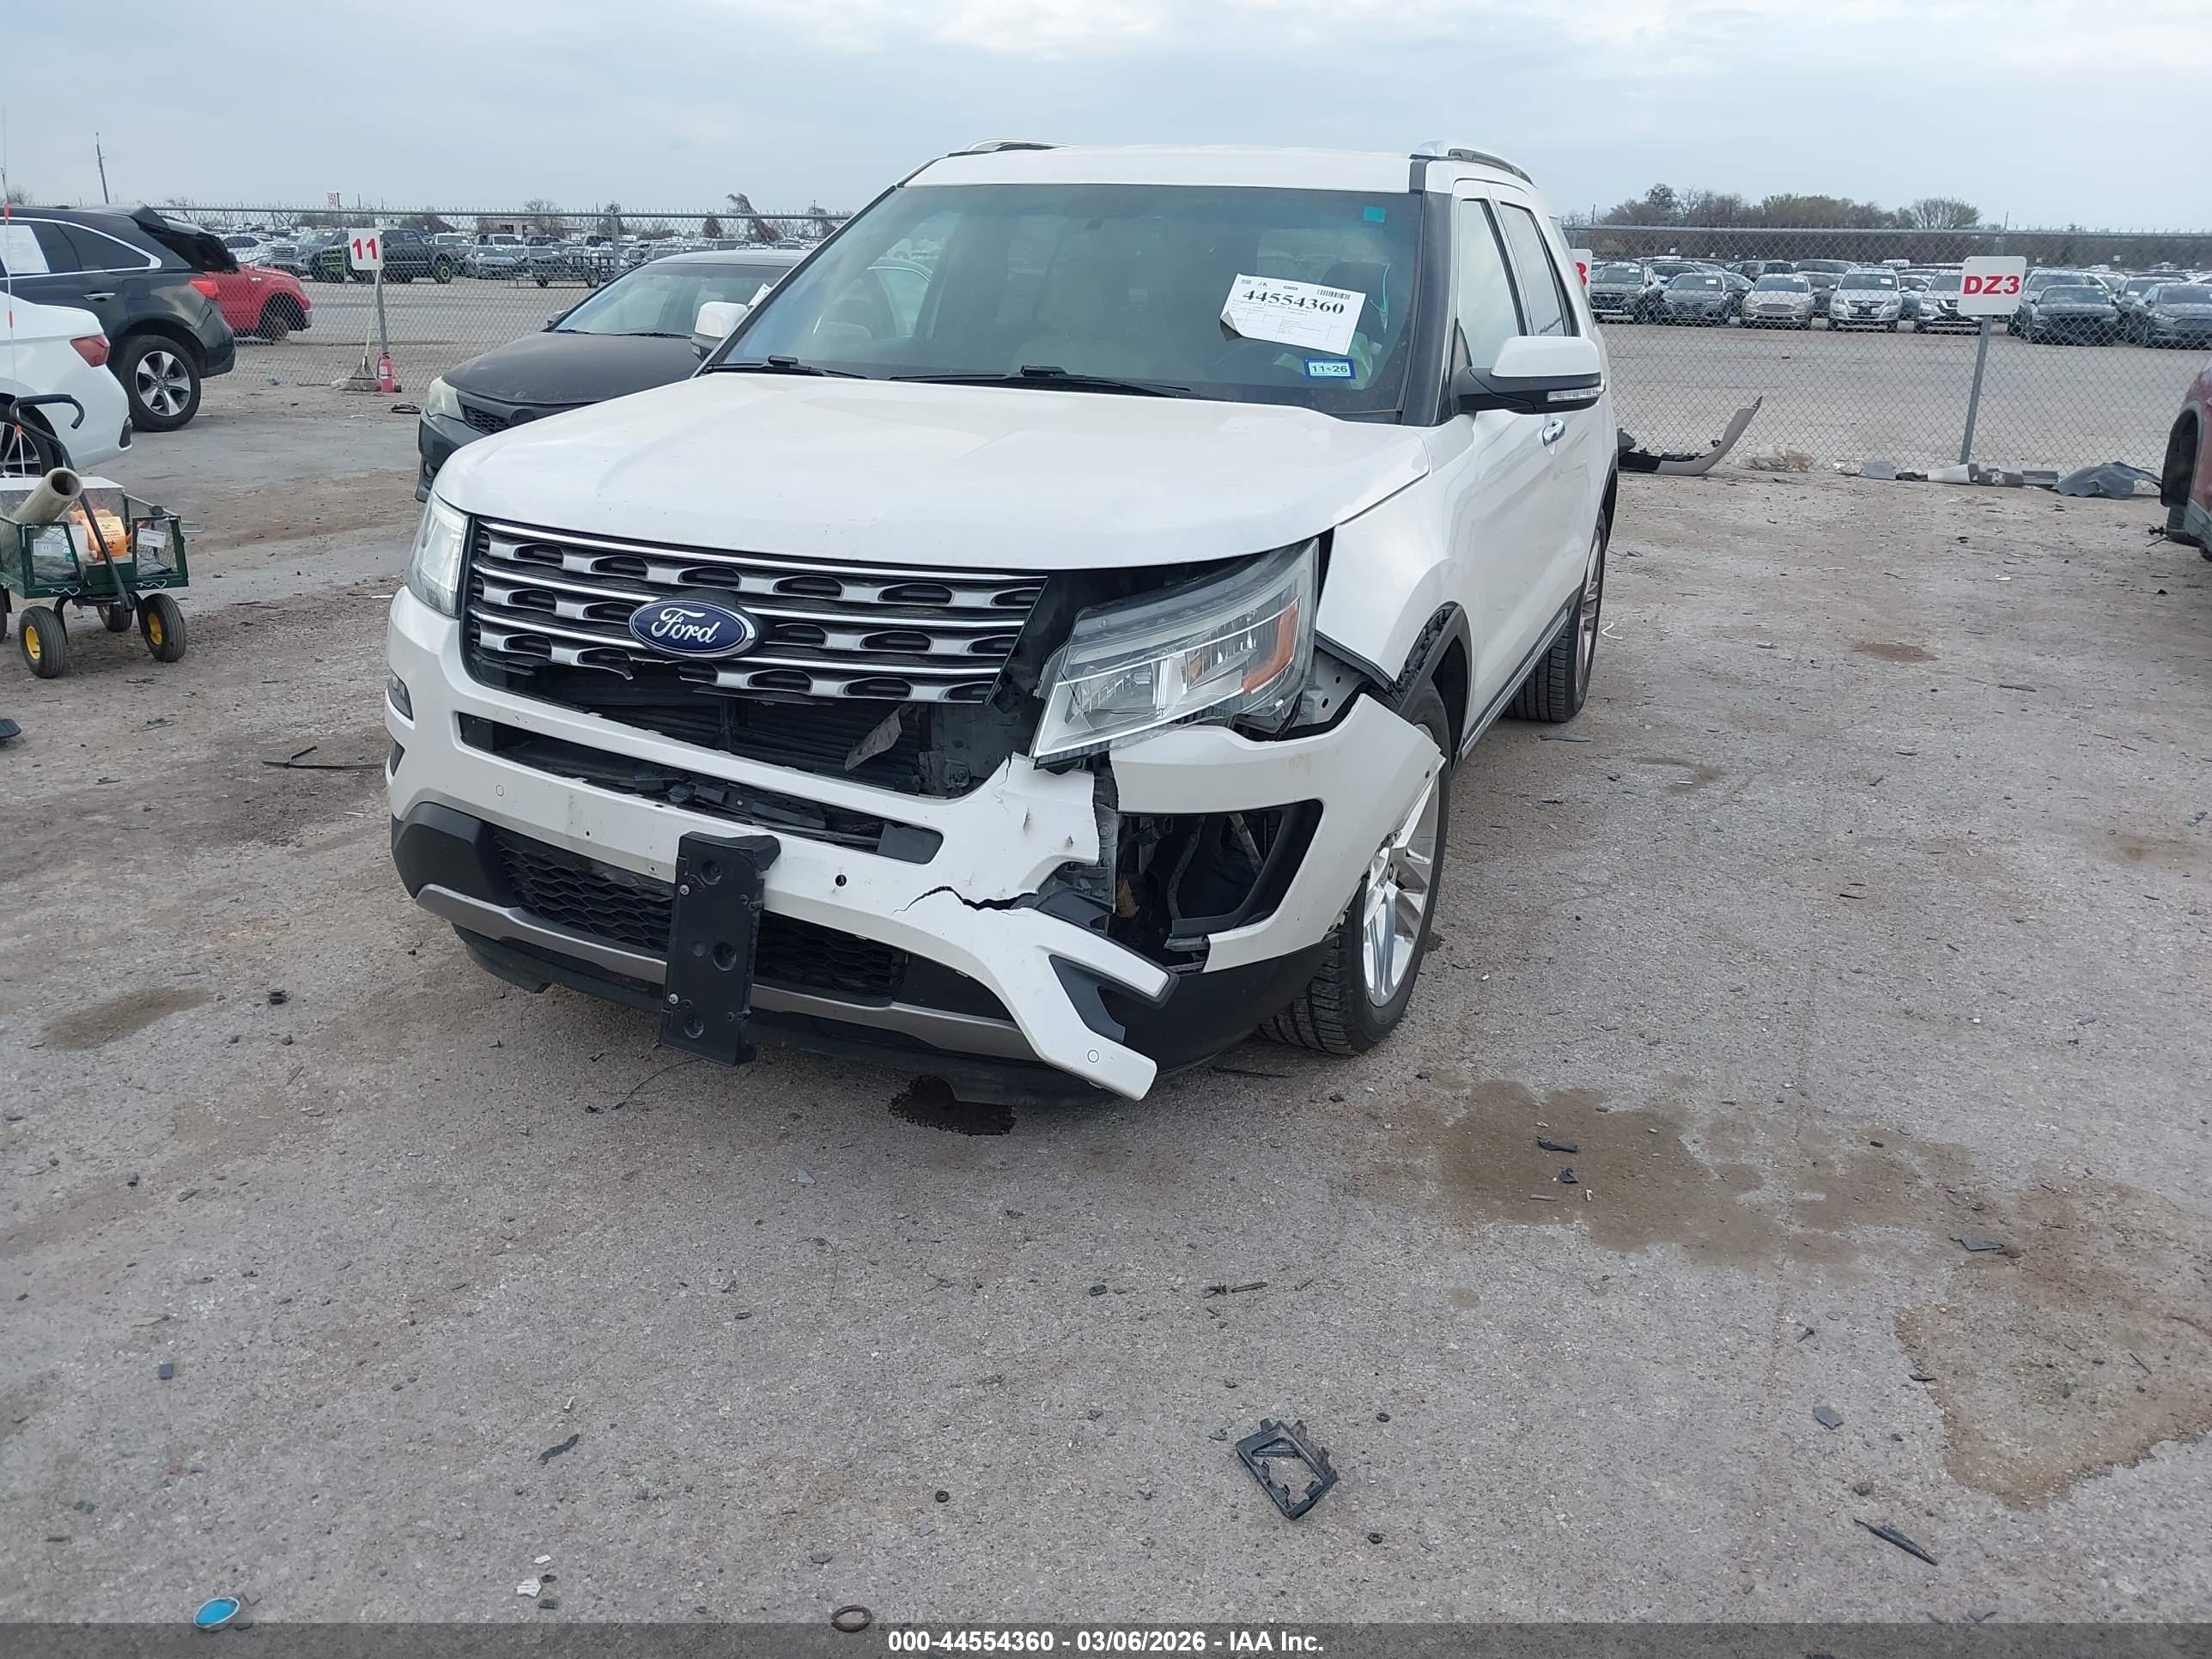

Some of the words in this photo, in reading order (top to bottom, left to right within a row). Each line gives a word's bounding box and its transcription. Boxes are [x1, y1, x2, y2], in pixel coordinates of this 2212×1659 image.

[351, 238, 378, 260] 11
[1963, 275, 2020, 295] DZ3
[1243, 289, 1345, 314] 44554360
[651, 607, 721, 644] Ford
